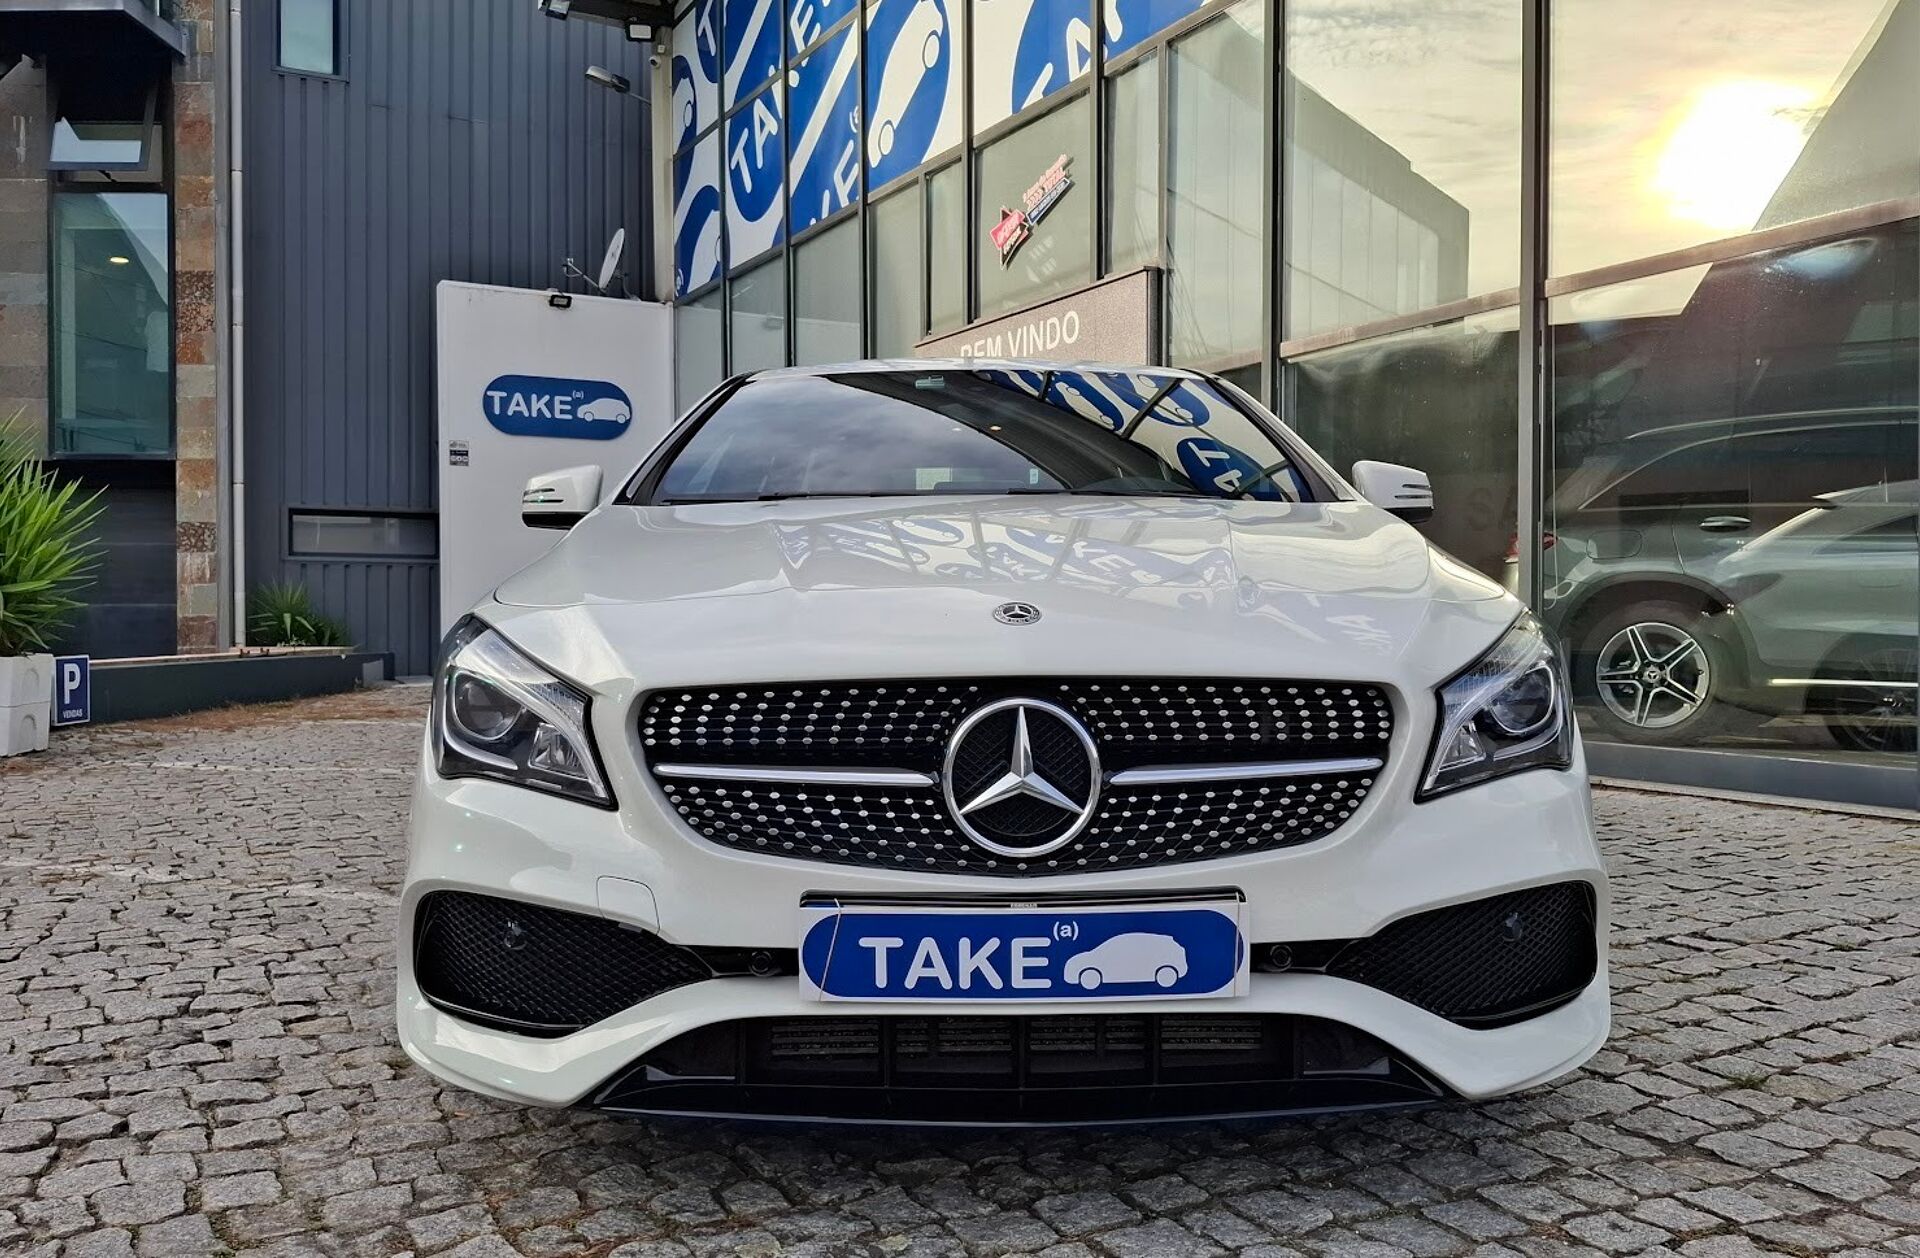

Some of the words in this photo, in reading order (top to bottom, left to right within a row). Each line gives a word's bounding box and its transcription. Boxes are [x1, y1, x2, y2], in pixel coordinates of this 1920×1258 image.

[1007, 311, 1080, 358] VINDO
[486, 390, 573, 420] TAKE
[63, 662, 81, 705] P
[858, 936, 1052, 990] TAKE
